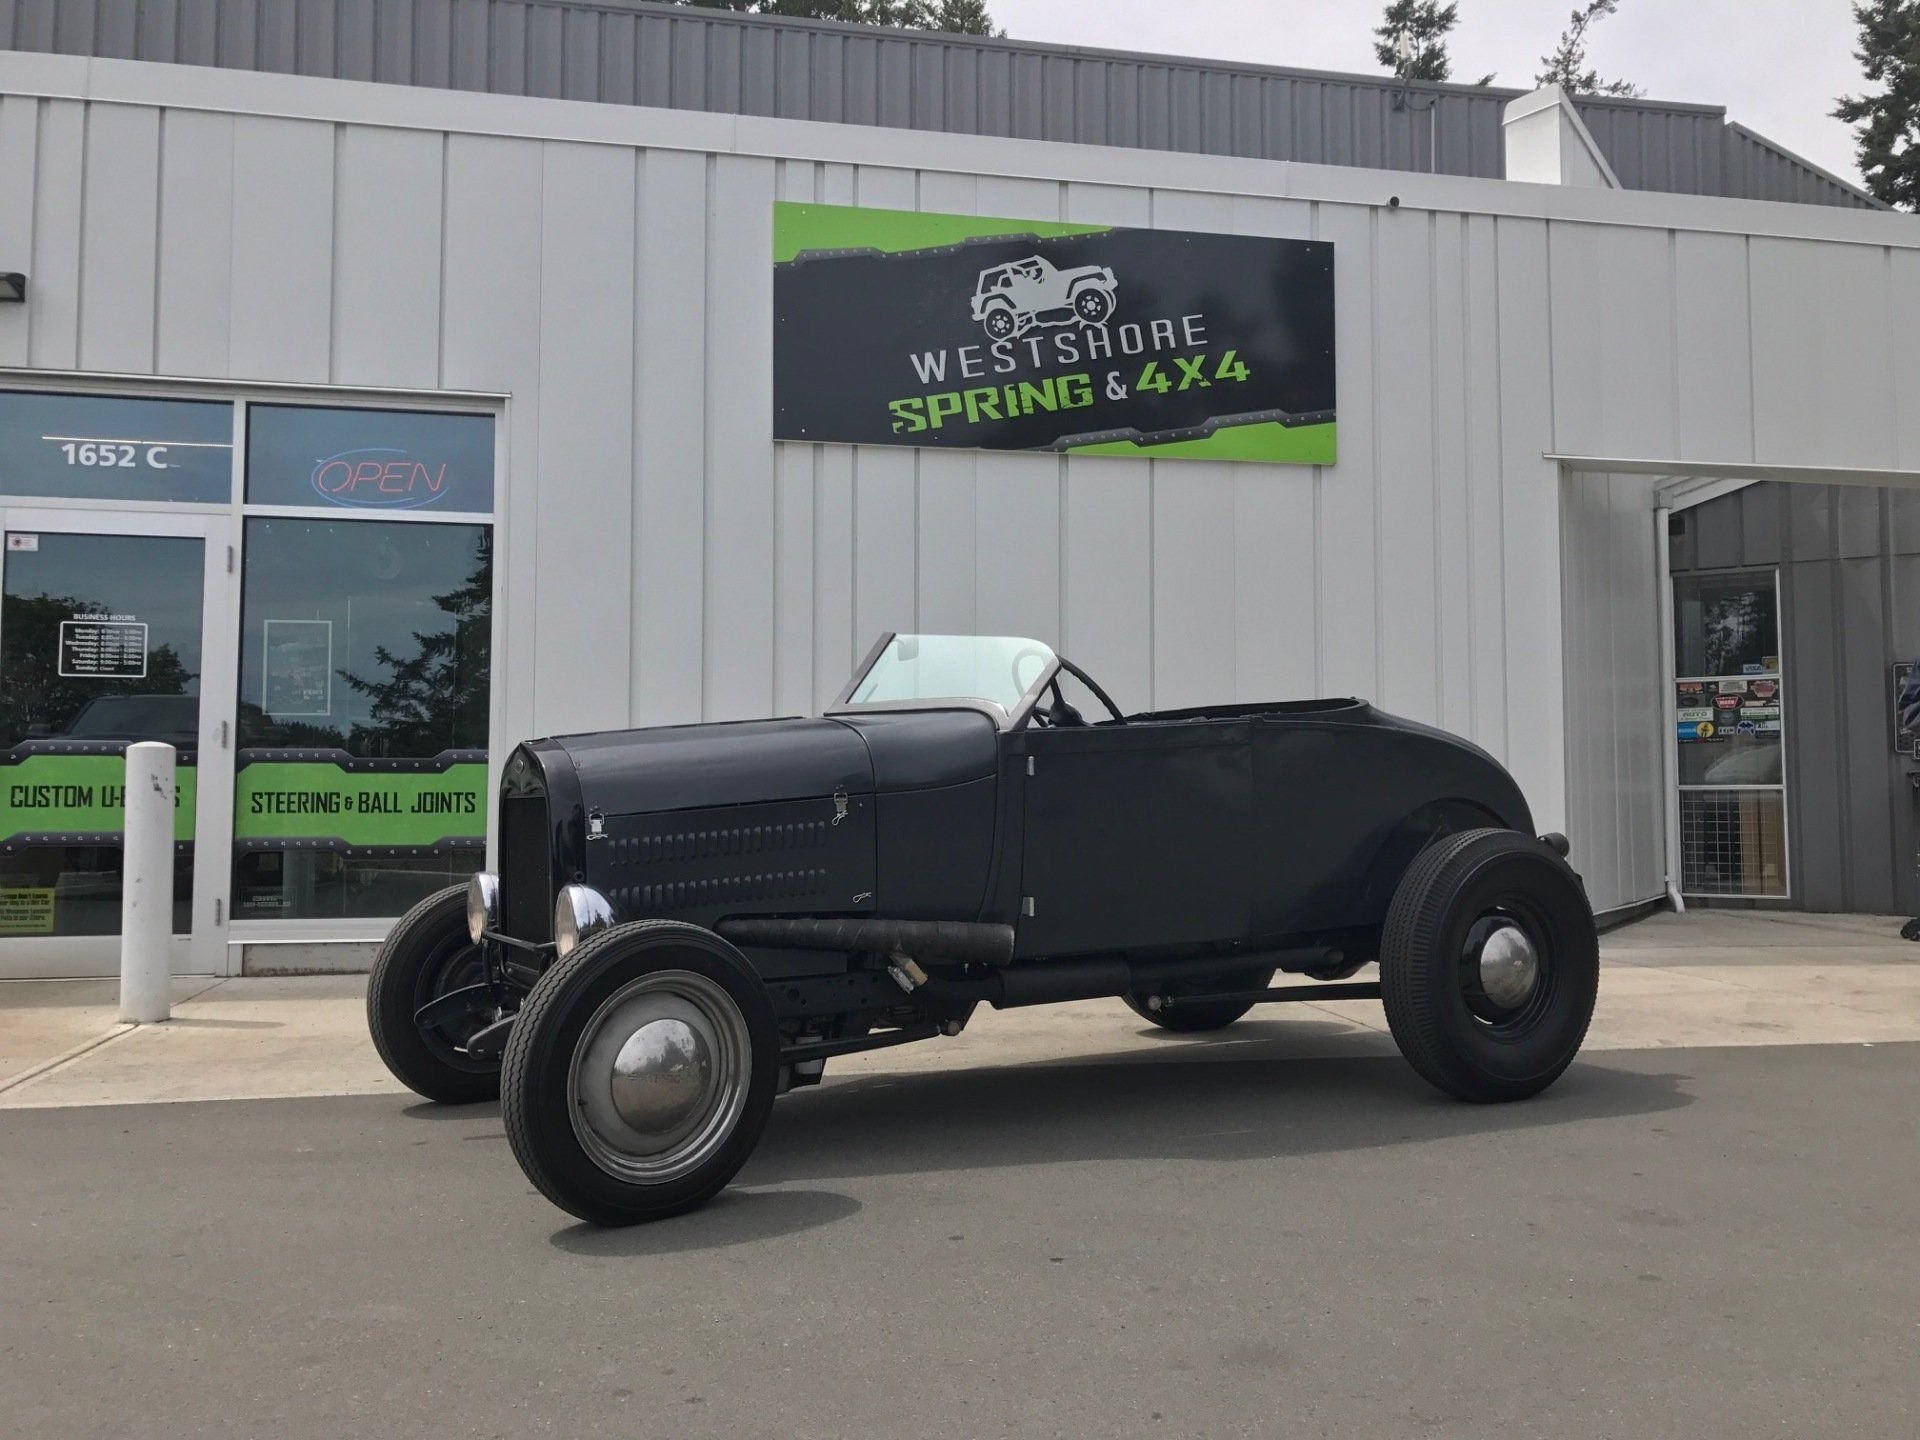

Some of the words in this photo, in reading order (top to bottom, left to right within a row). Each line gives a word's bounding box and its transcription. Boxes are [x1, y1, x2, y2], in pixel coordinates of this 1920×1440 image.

[909, 313, 1209, 385] WESTSHORE
[888, 372, 1095, 434] SPRING
[1105, 370, 1129, 401] &
[1135, 350, 1251, 394] 4X4
[61, 443, 136, 468] 1652
[146, 446, 168, 469] C
[318, 461, 447, 492] OPEN
[73, 613, 109, 621] BUSINESS
[110, 614, 136, 622] HOURS
[10, 785, 93, 808] CUSTOM
[251, 791, 341, 814] STEERING
[344, 796, 353, 811] &
[358, 791, 403, 814] BALL
[410, 791, 476, 814] JOINTS
